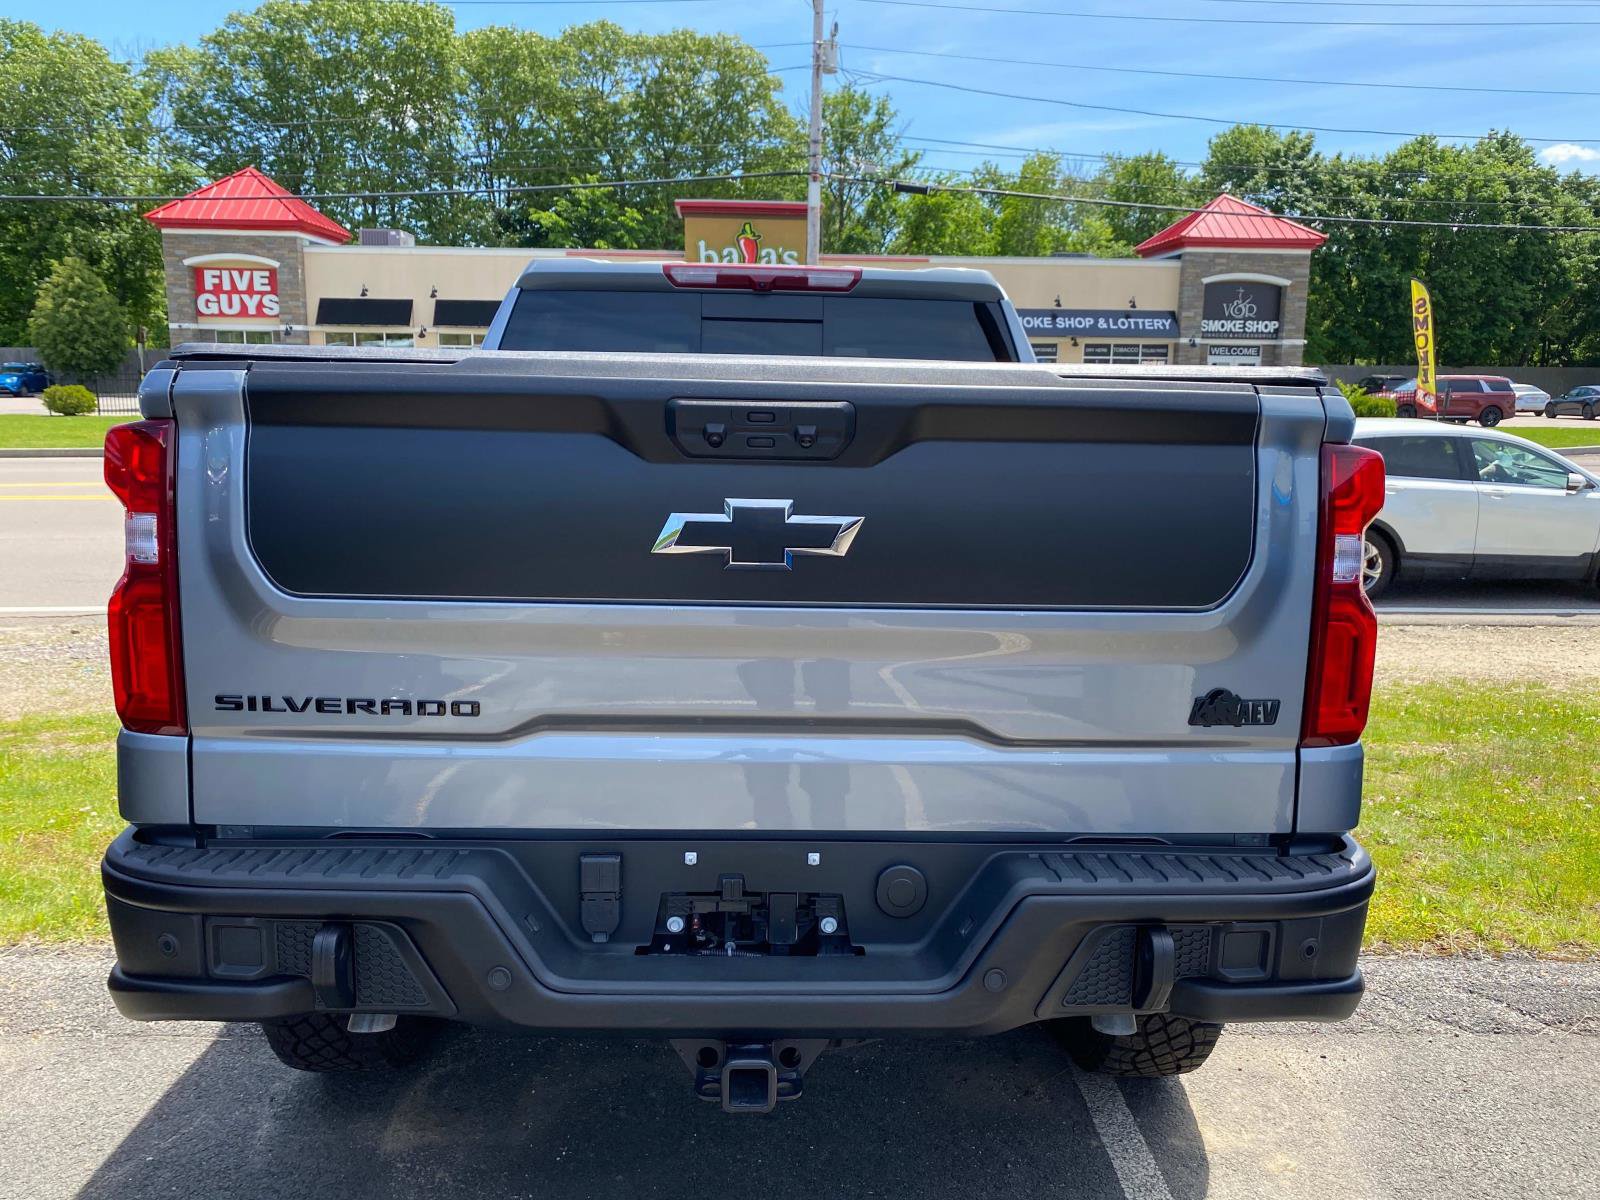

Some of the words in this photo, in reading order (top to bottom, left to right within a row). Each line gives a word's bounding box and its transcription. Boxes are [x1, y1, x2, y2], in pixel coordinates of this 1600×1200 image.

[203, 269, 272, 292] FIVE
[197, 293, 280, 316] GUYS
[1019, 316, 1053, 328] OKE
[1056, 316, 1094, 329] SHOP
[1098, 317, 1108, 329] &
[1110, 317, 1171, 330] LOTTERY
[1201, 319, 1244, 332] SMOKE
[1244, 320, 1279, 333] SHOP
[1210, 346, 1259, 356] WELCOME
[214, 694, 481, 718] SILVERADO
[1237, 701, 1277, 723] AEV
